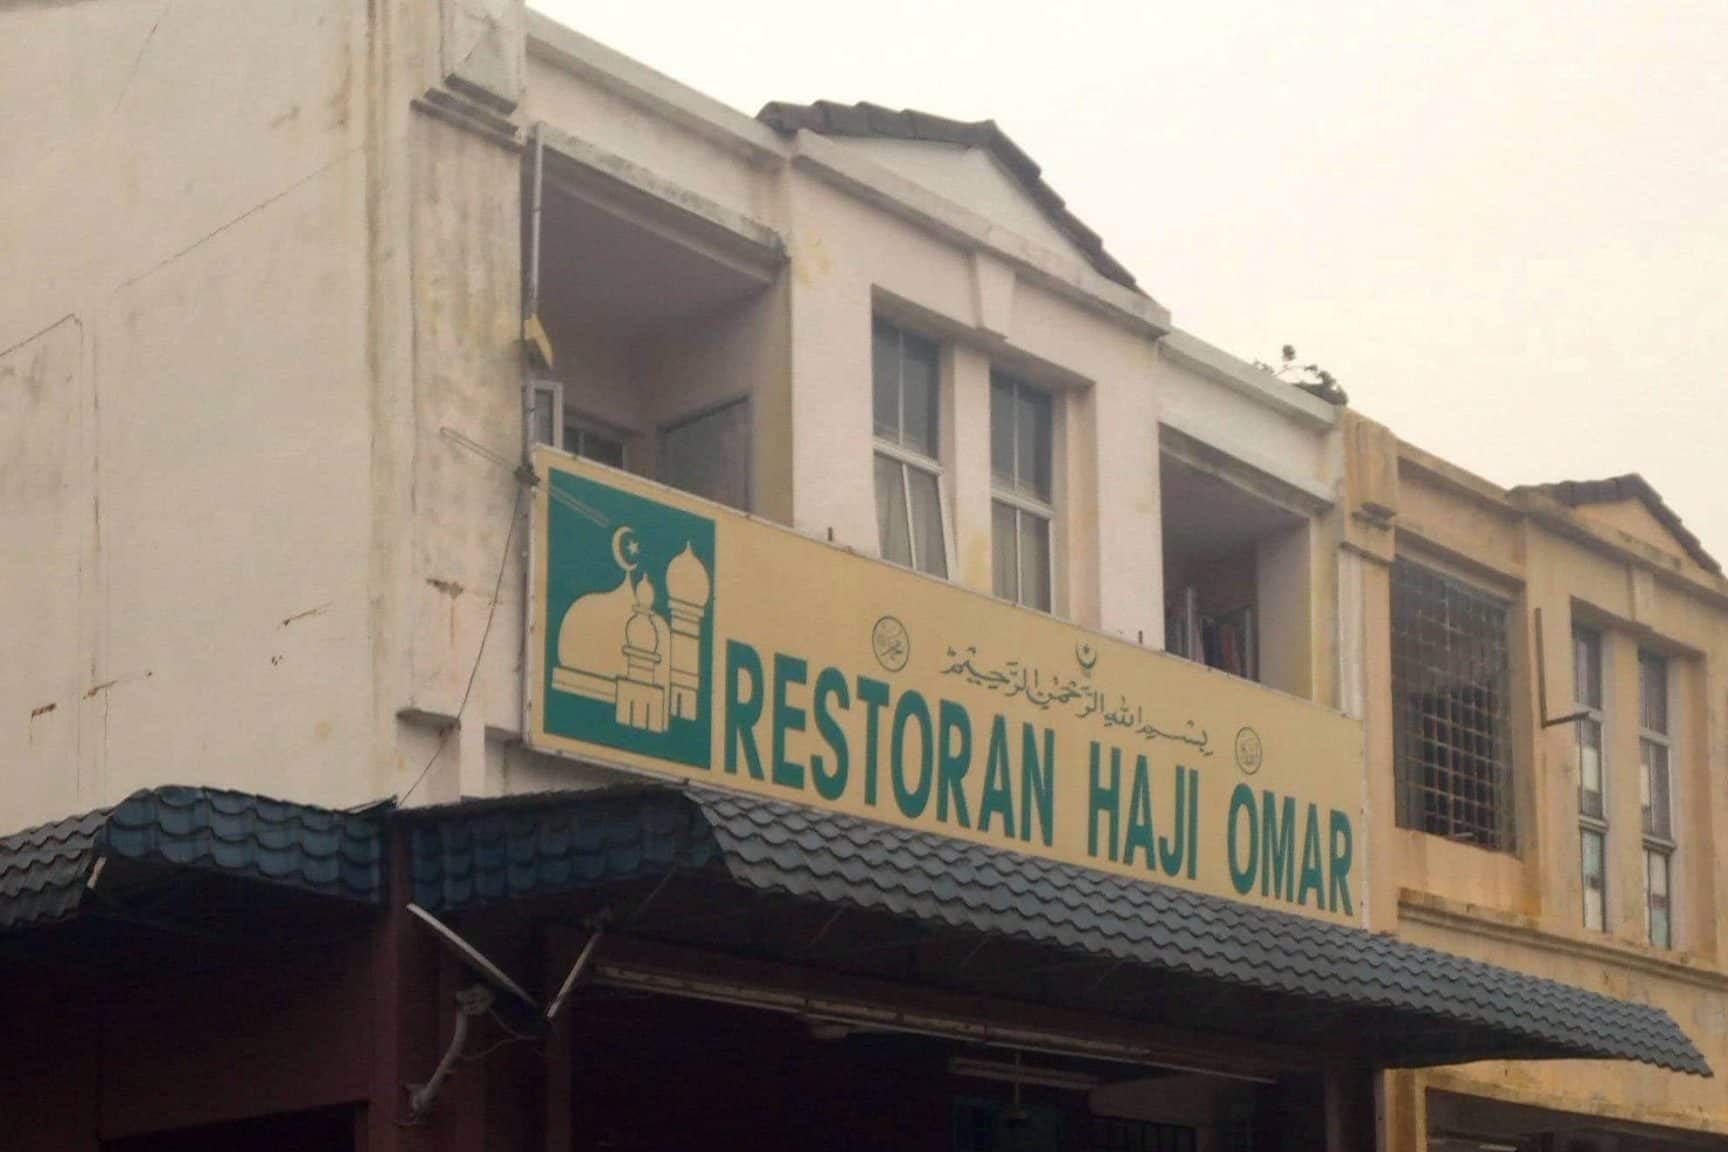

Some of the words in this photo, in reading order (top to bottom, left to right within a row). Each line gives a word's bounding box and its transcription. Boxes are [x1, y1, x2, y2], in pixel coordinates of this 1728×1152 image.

[723, 640, 1055, 847] RESTORAN
[1087, 741, 1198, 881] HAJI
[1227, 784, 1354, 917] OMAR
